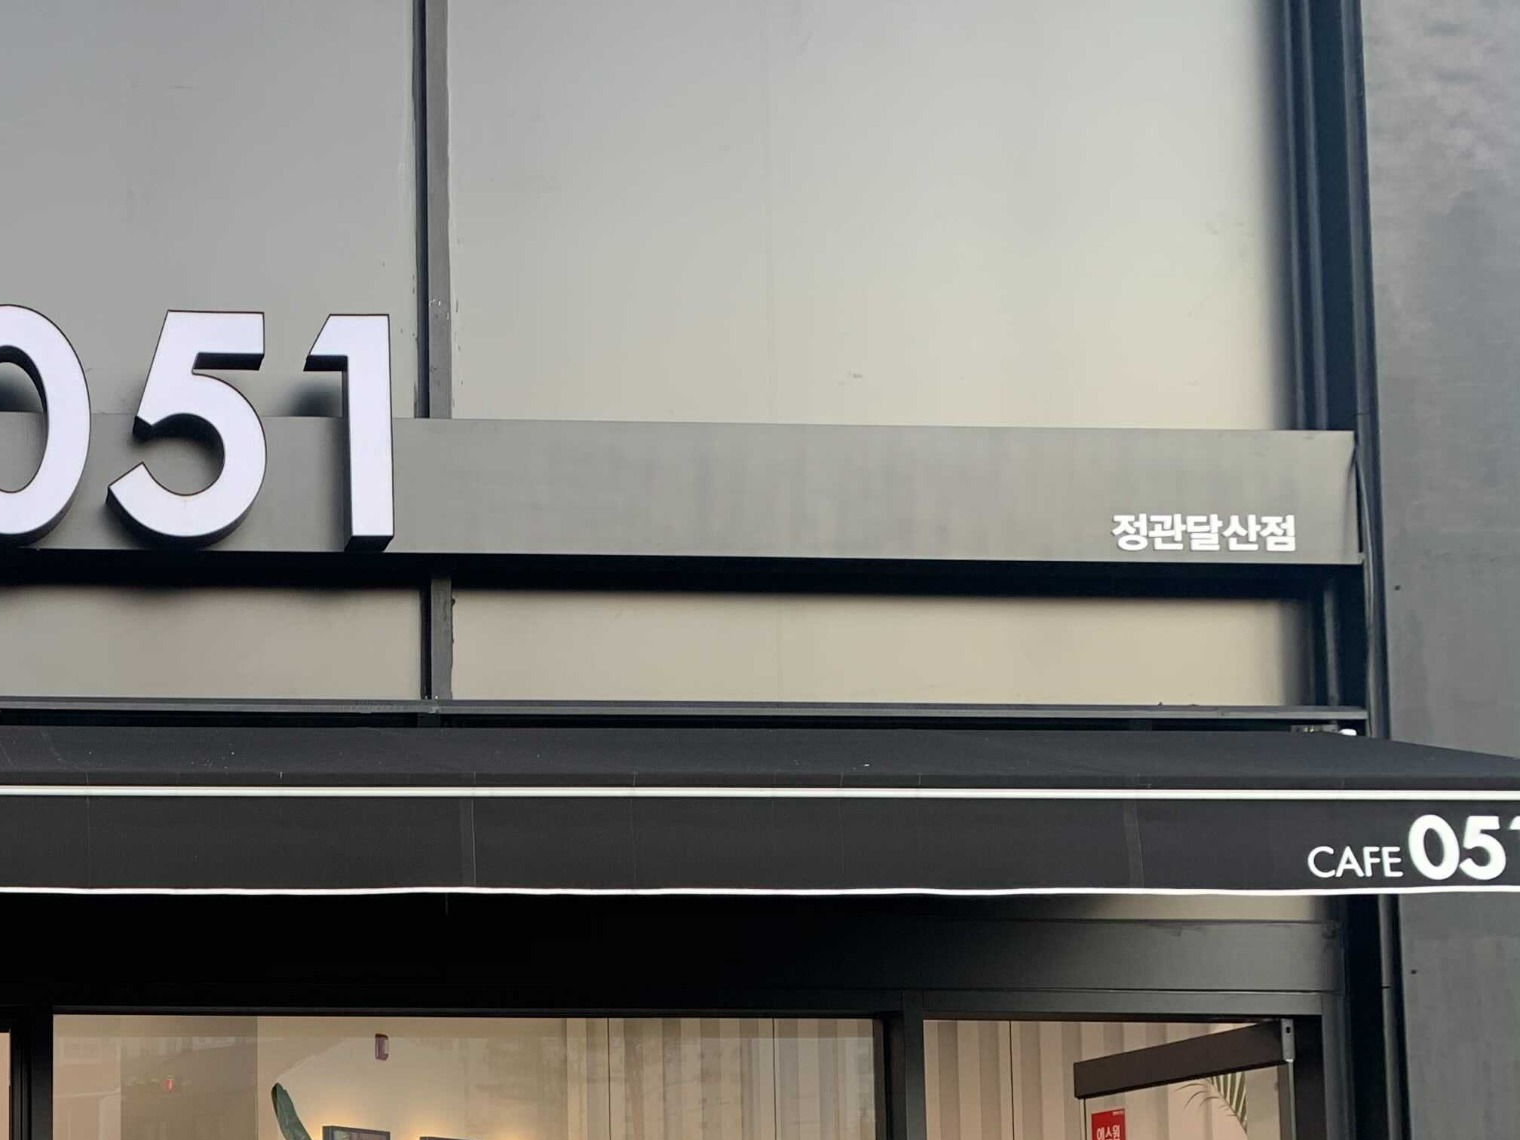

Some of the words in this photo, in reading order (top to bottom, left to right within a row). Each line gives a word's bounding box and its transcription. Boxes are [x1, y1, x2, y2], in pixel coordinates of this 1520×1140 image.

[1111, 513, 1296, 552] 정관달산점
[1307, 845, 1404, 878] CAFE
[1408, 813, 1520, 881] 05
